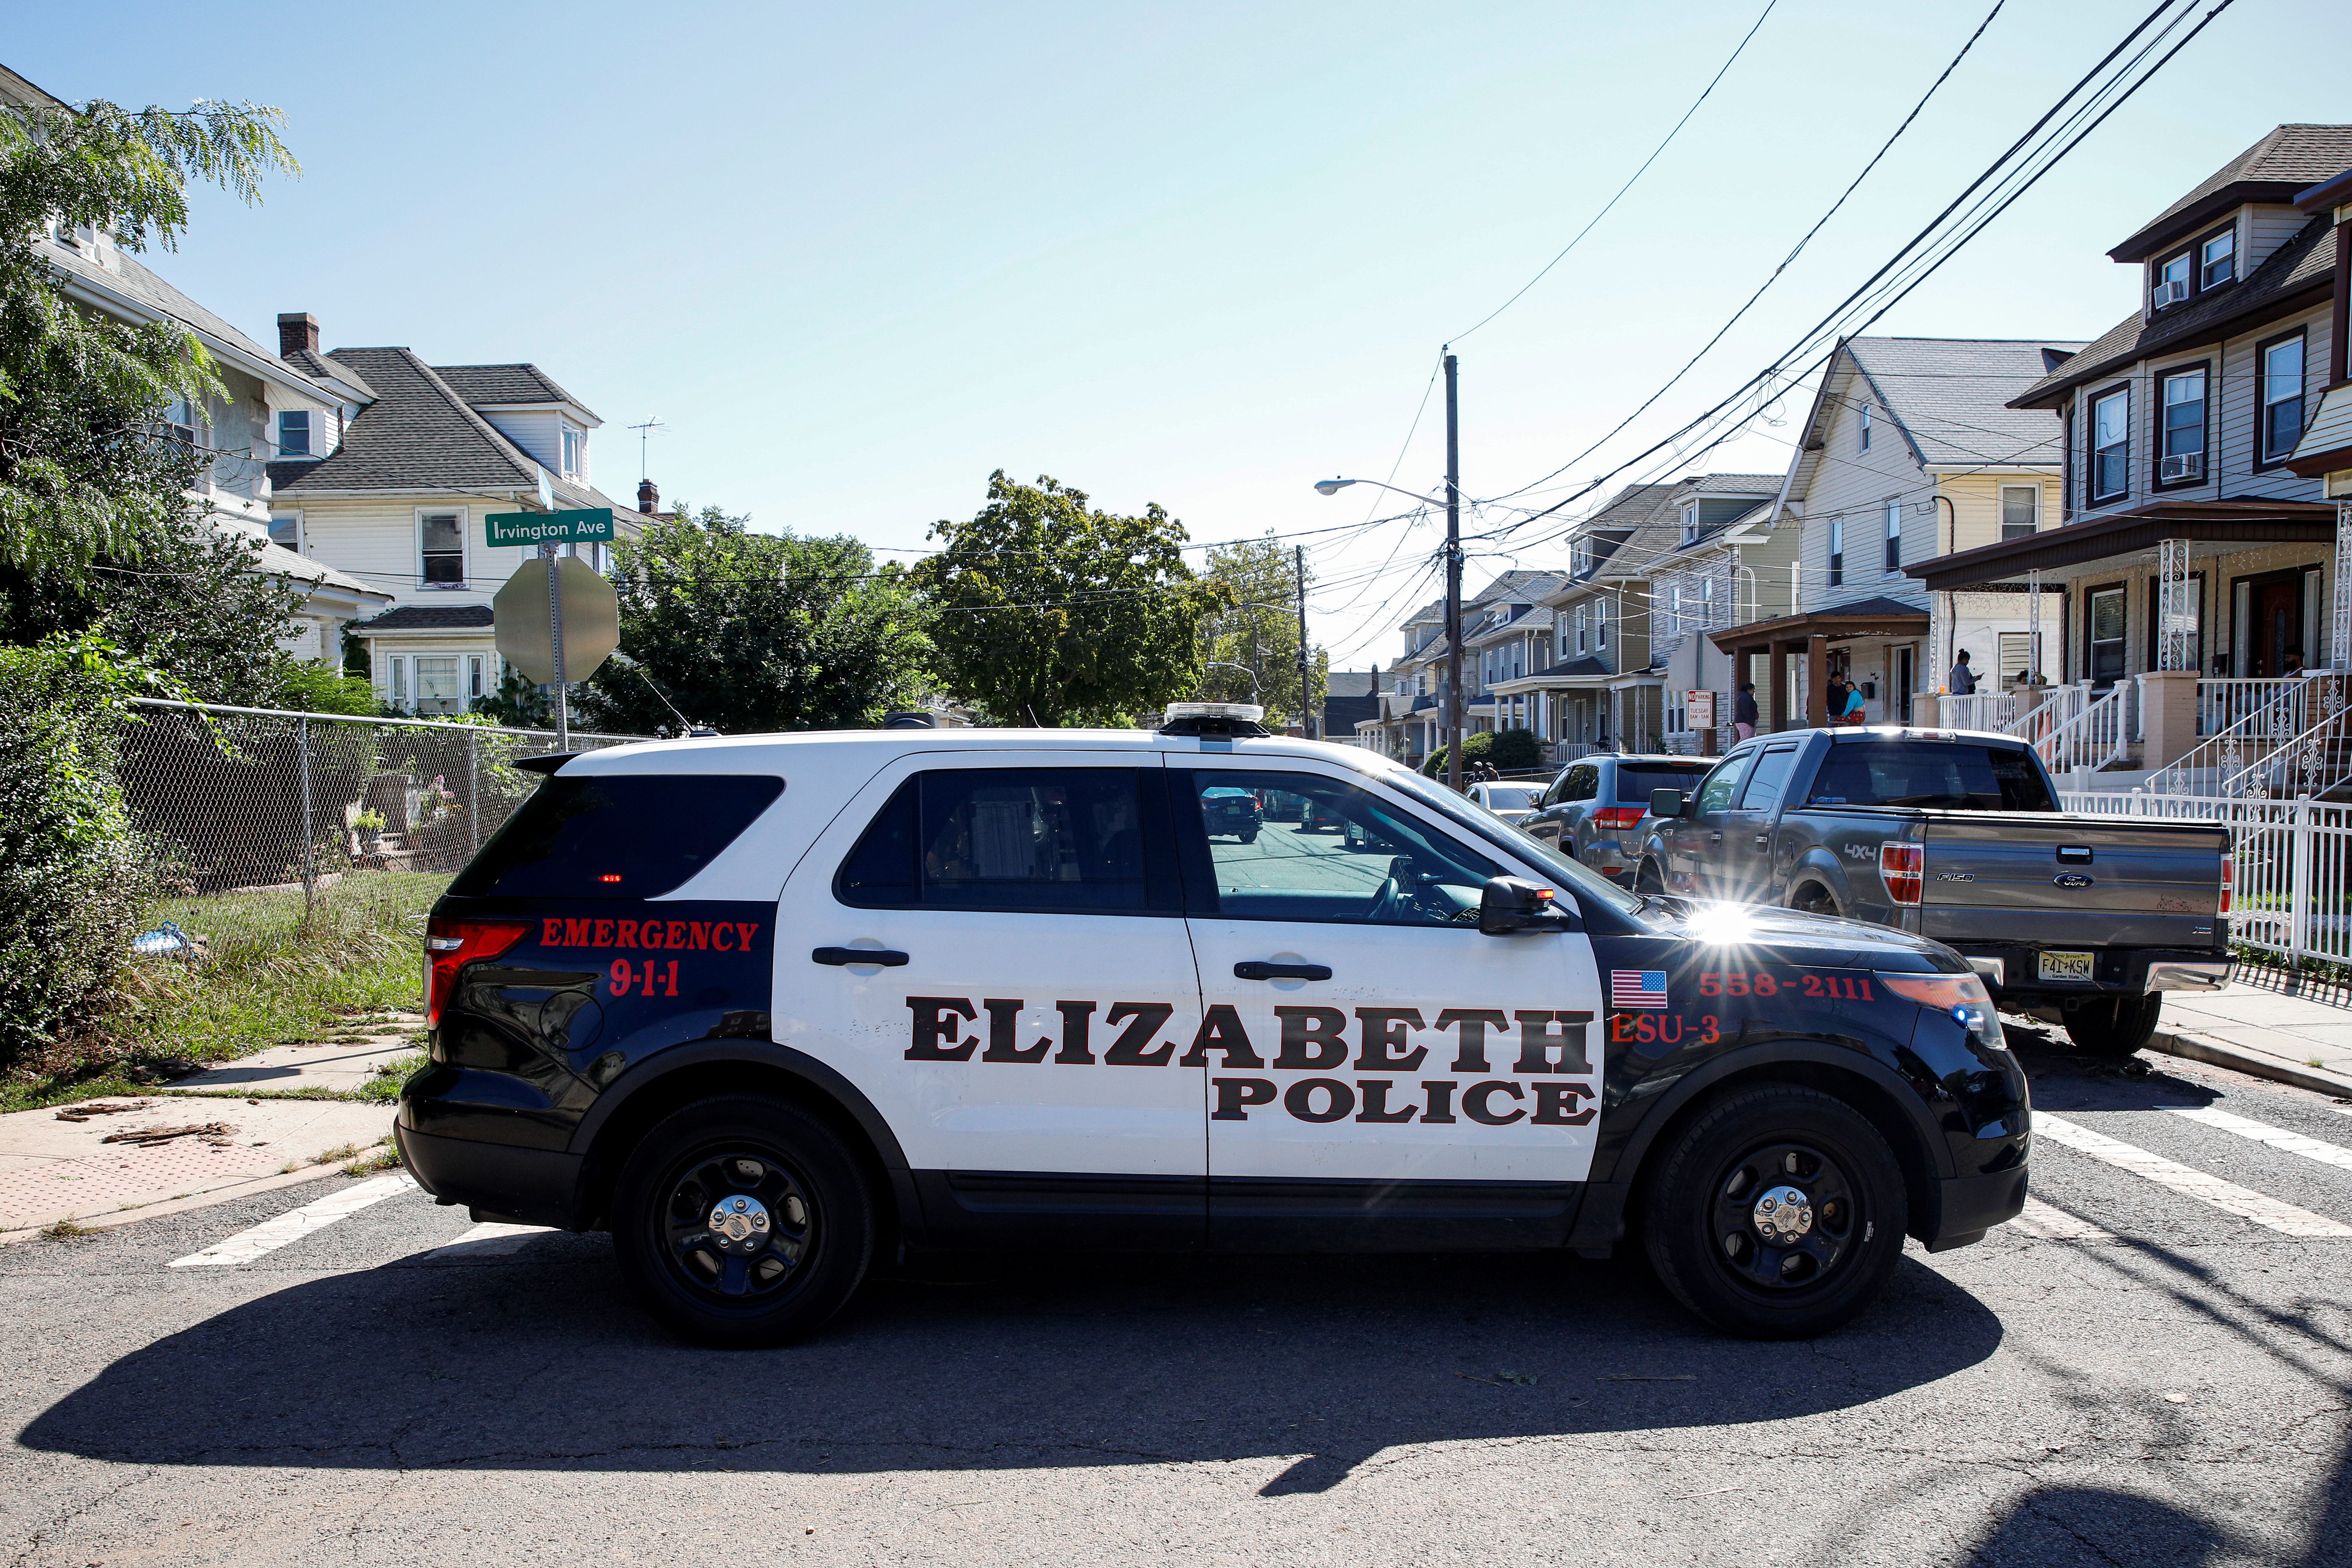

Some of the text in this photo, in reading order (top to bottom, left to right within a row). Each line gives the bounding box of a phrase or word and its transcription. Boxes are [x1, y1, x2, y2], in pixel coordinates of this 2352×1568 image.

[494, 521, 606, 540] Irvington Ave
[1937, 873, 1975, 882] F-150
[2064, 876, 2087, 886] Ford
[540, 918, 759, 951] EMERGENCY
[609, 959, 678, 996] 9-1-1
[1699, 971, 1875, 1001] 558-2111
[904, 996, 1595, 1075] ELIZABETH
[1611, 1013, 1720, 1044] ESU-3
[1211, 1077, 1598, 1126] POLICE
